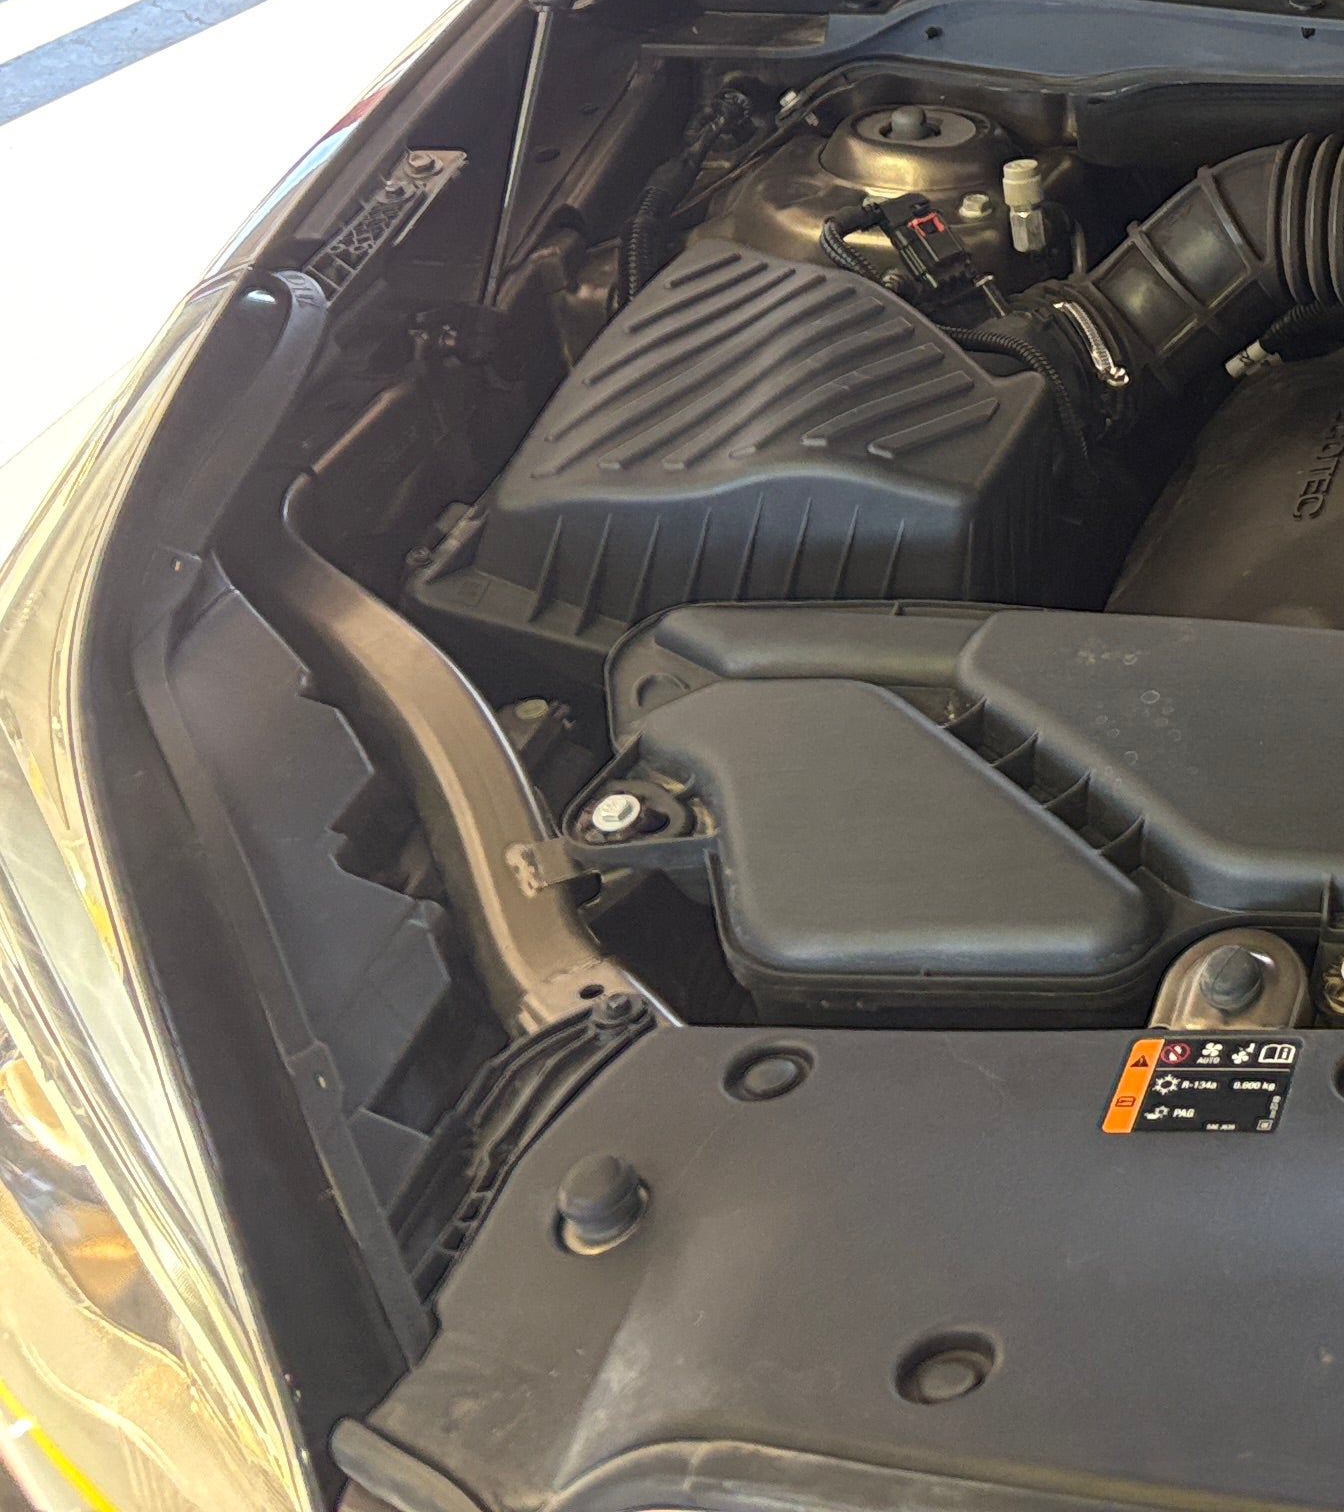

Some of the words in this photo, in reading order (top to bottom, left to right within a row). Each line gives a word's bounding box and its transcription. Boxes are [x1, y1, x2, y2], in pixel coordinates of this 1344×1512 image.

[1196, 1056, 1221, 1065] AUTO
[1181, 1080, 1218, 1090] R-134a
[1261, 1080, 1276, 1092] kg
[1173, 1108, 1195, 1118] PAG
